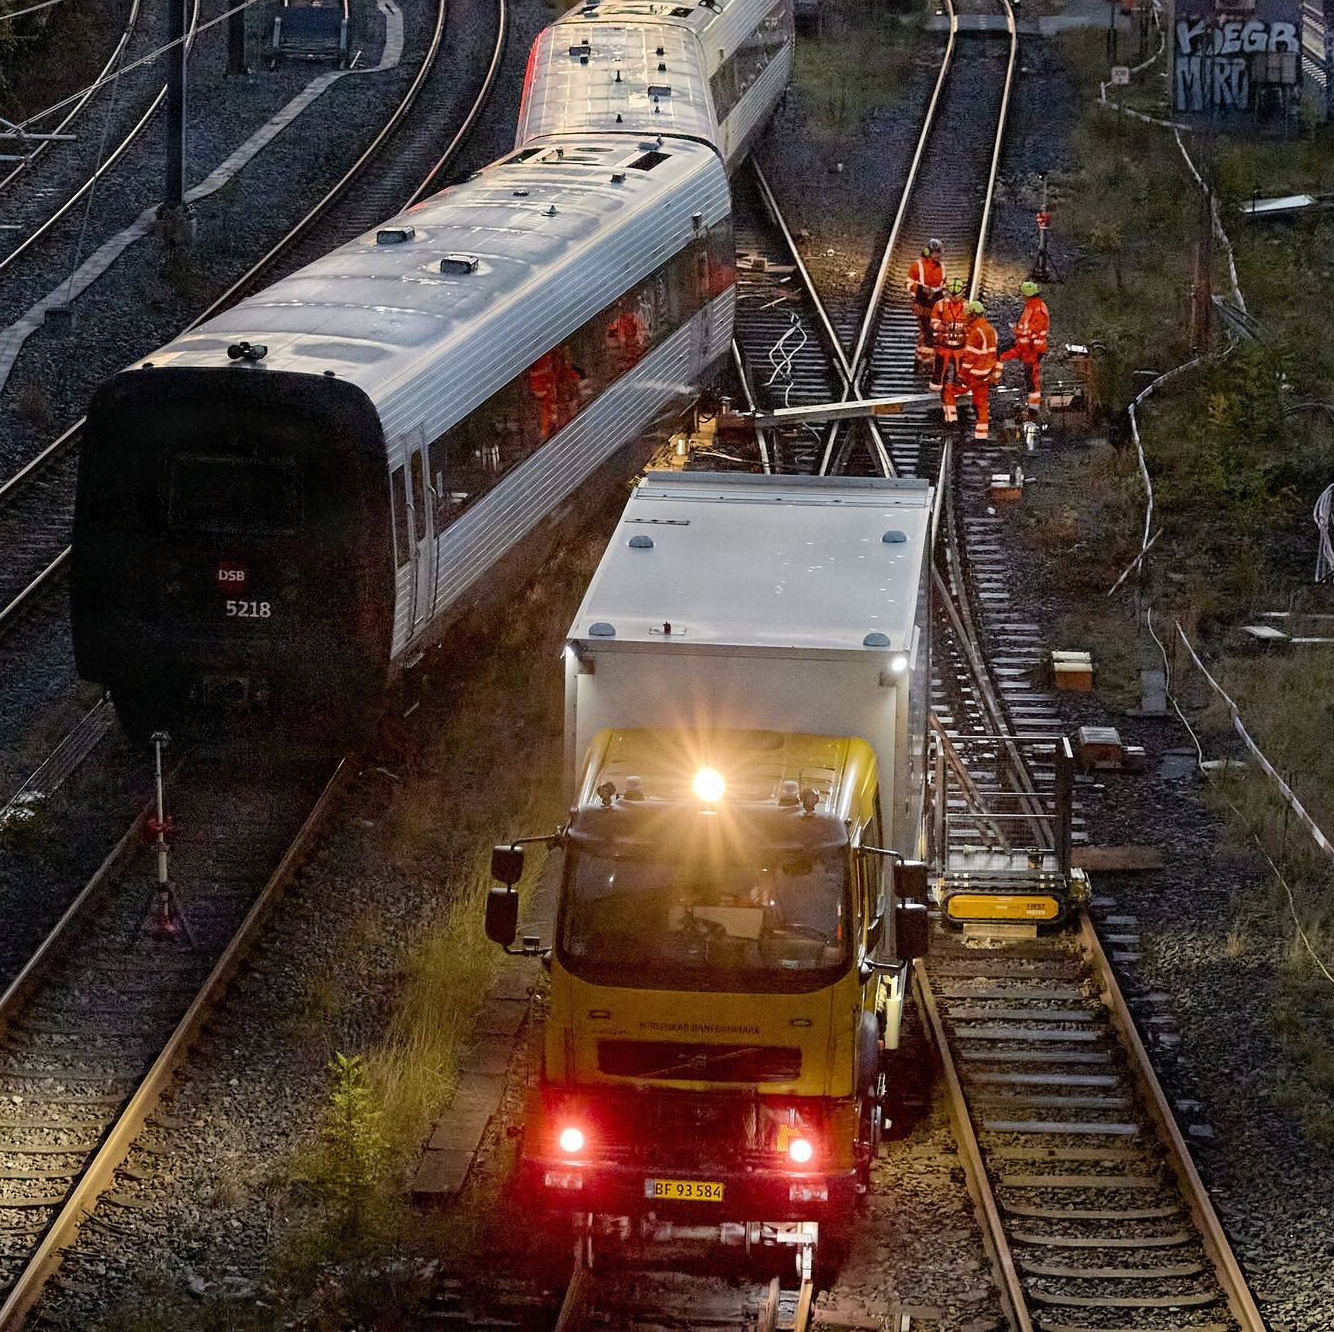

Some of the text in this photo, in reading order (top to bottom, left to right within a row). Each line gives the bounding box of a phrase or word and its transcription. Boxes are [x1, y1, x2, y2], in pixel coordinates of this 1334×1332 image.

[218, 569, 245, 582] DSB
[226, 600, 272, 618] 5218
[655, 1183, 721, 1198] BF 93 584
